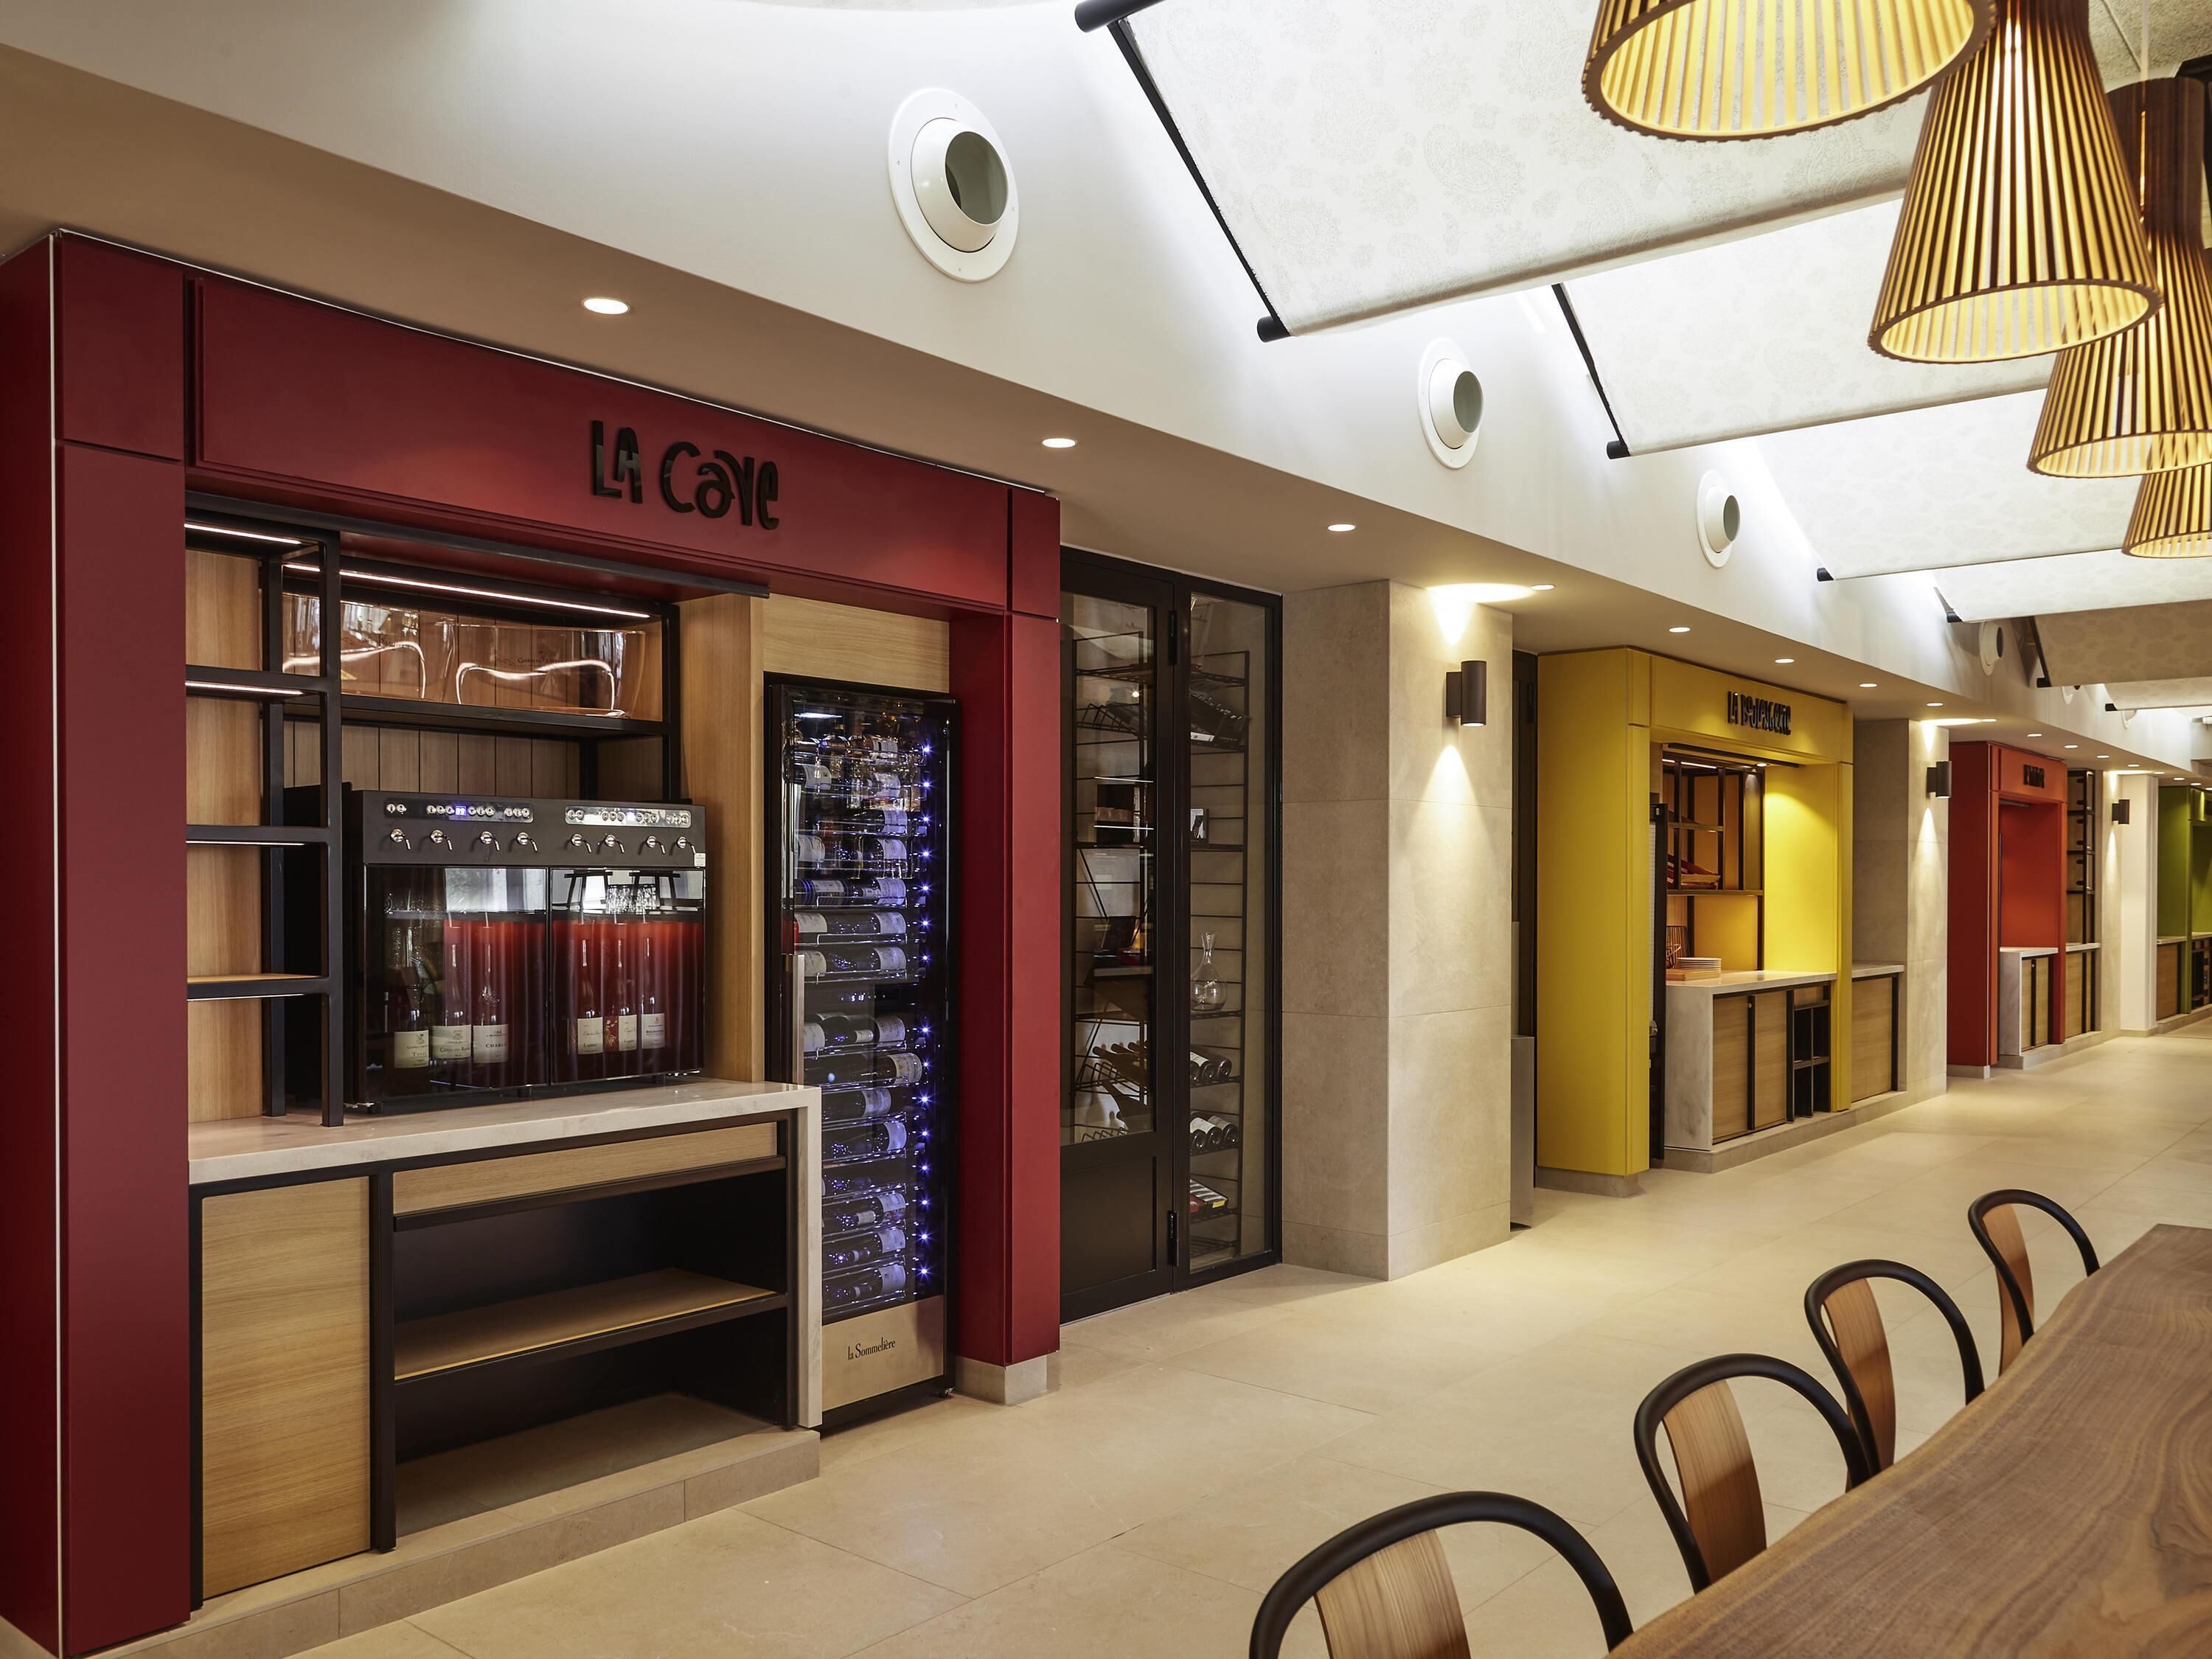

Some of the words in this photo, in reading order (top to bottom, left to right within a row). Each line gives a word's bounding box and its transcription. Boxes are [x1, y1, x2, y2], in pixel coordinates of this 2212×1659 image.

[592, 420, 643, 504] LA
[1728, 691, 1739, 725] LA
[848, 1346, 854, 1360] la
[855, 1336, 896, 1359] Sommelière
